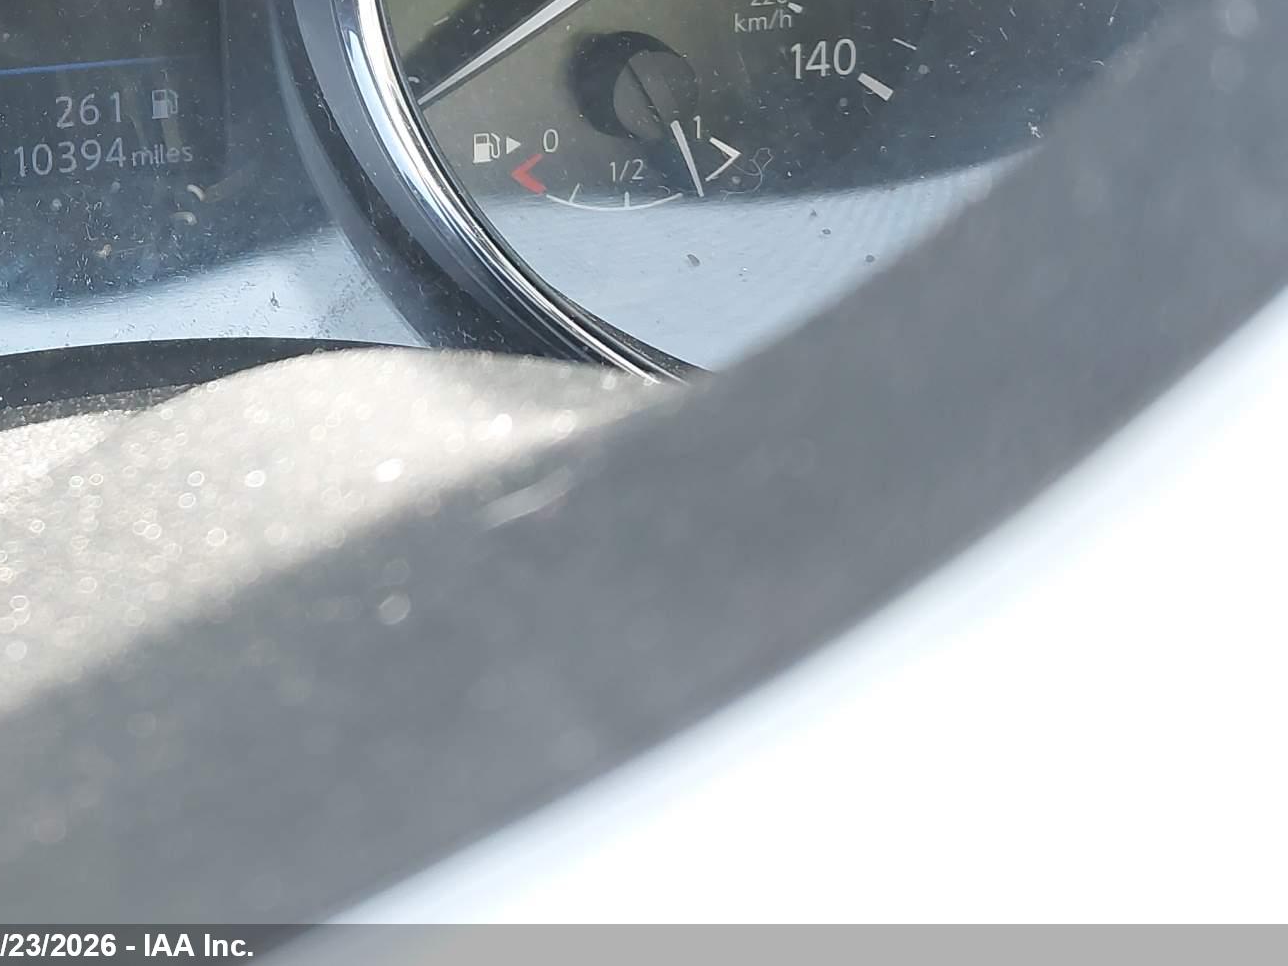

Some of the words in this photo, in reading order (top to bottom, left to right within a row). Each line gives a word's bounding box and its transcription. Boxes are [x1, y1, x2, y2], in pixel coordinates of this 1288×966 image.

[733, 9, 793, 33] km/h
[790, 38, 858, 81] 140
[55, 92, 122, 129] 261
[693, 115, 704, 139] 1
[543, 128, 559, 153] 0
[131, 143, 193, 167] miles
[609, 158, 645, 183] 1/2
